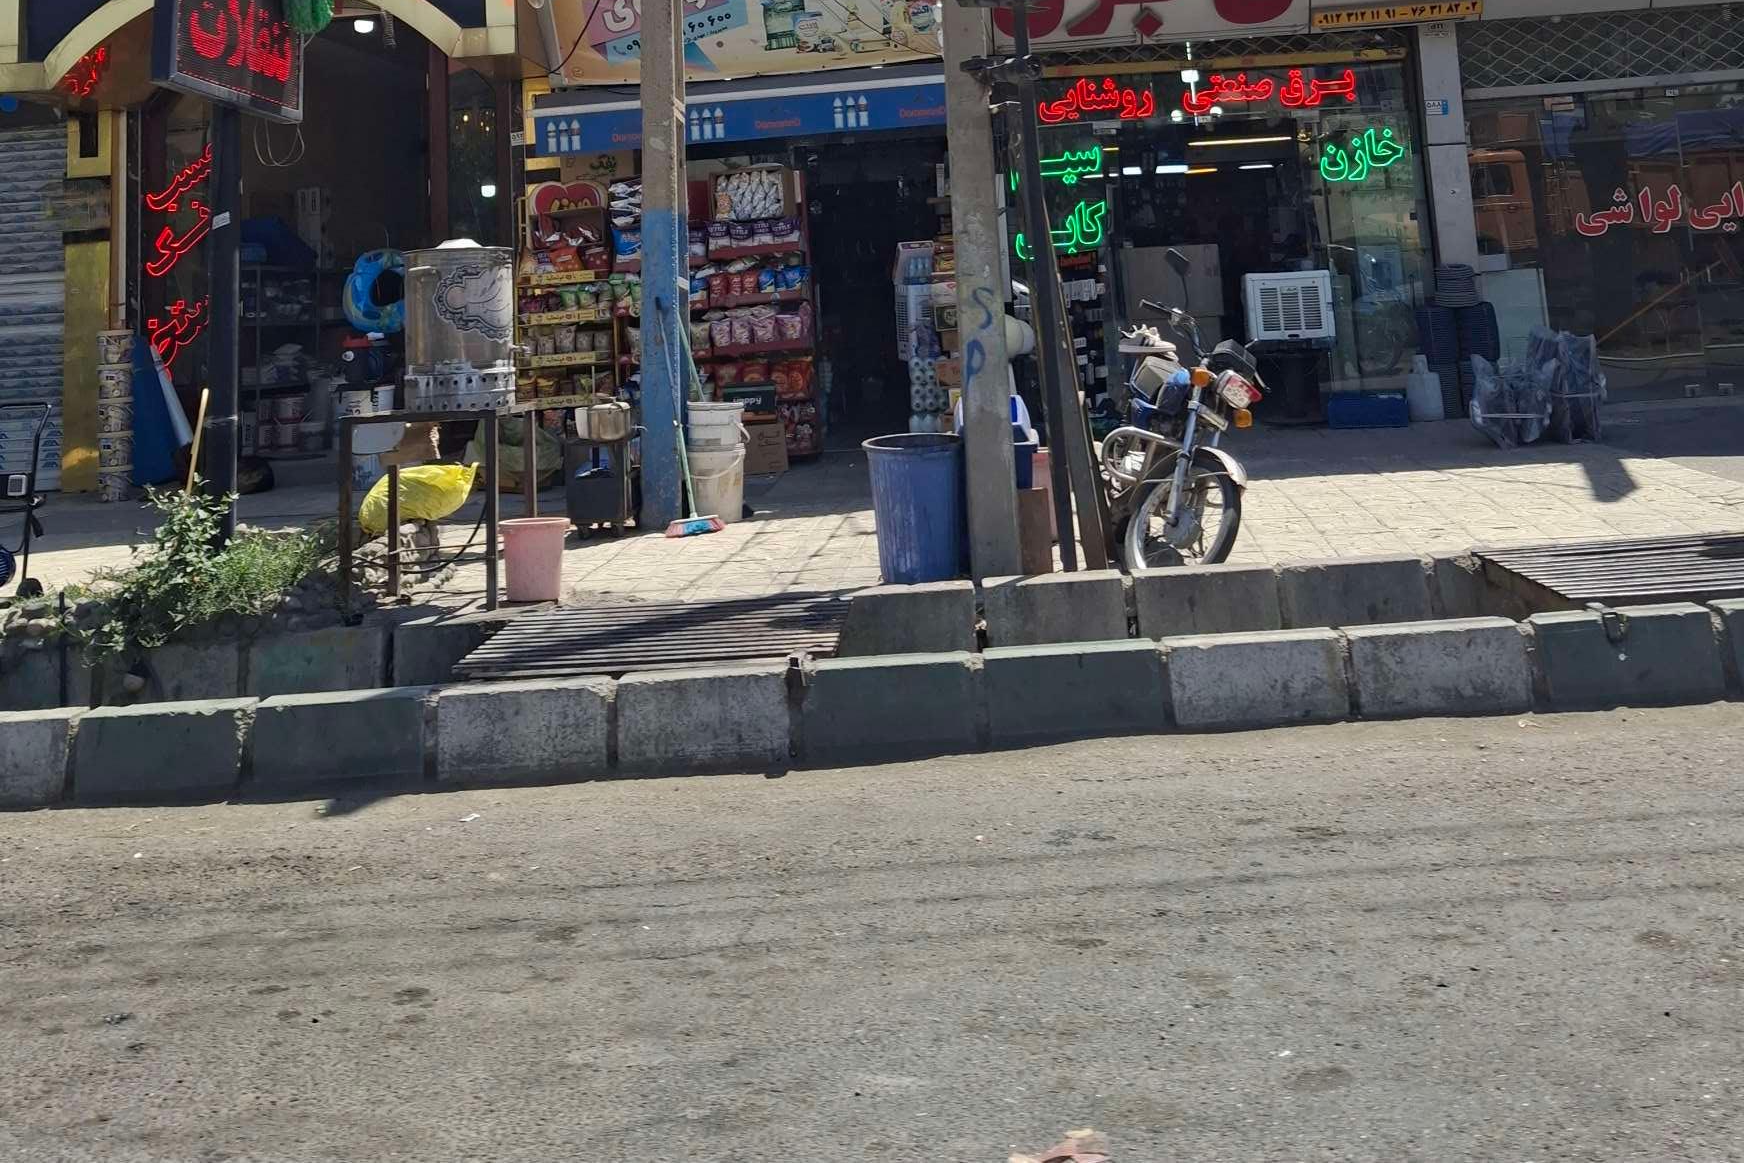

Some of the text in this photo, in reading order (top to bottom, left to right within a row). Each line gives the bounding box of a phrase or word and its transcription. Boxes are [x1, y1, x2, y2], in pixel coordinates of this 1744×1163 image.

[1038, 68, 1358, 124] برق صنعتی روشنایی
[1320, 127, 1404, 182] خازن
